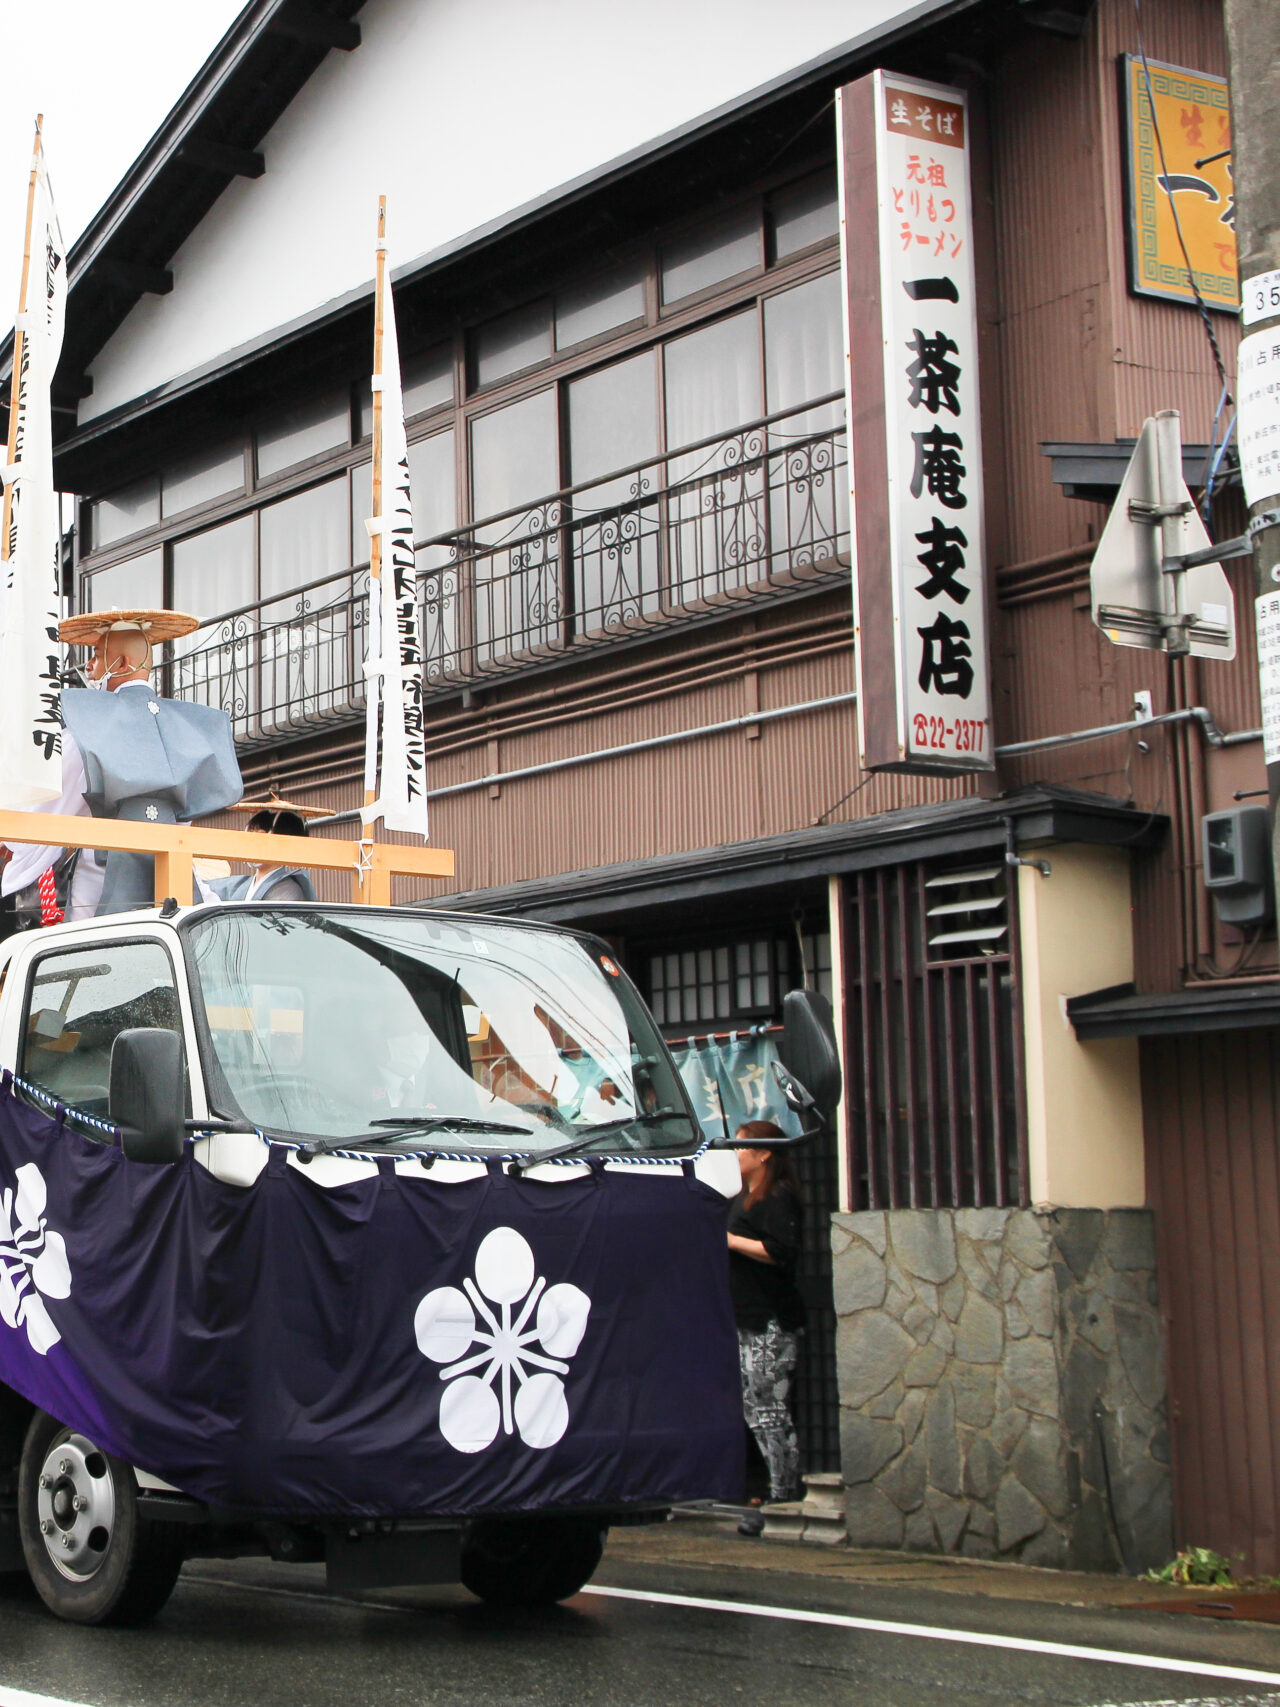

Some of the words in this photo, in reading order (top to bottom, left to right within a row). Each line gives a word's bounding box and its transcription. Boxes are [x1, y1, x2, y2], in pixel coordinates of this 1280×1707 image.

[890, 99, 957, 136] 生そば
[906, 155, 947, 188] 元祖
[892, 186, 956, 223] とりもつ
[900, 222, 963, 258] ラーメン
[902, 276, 974, 700] 一茶庵支店
[929, 716, 984, 752] 22-2377
